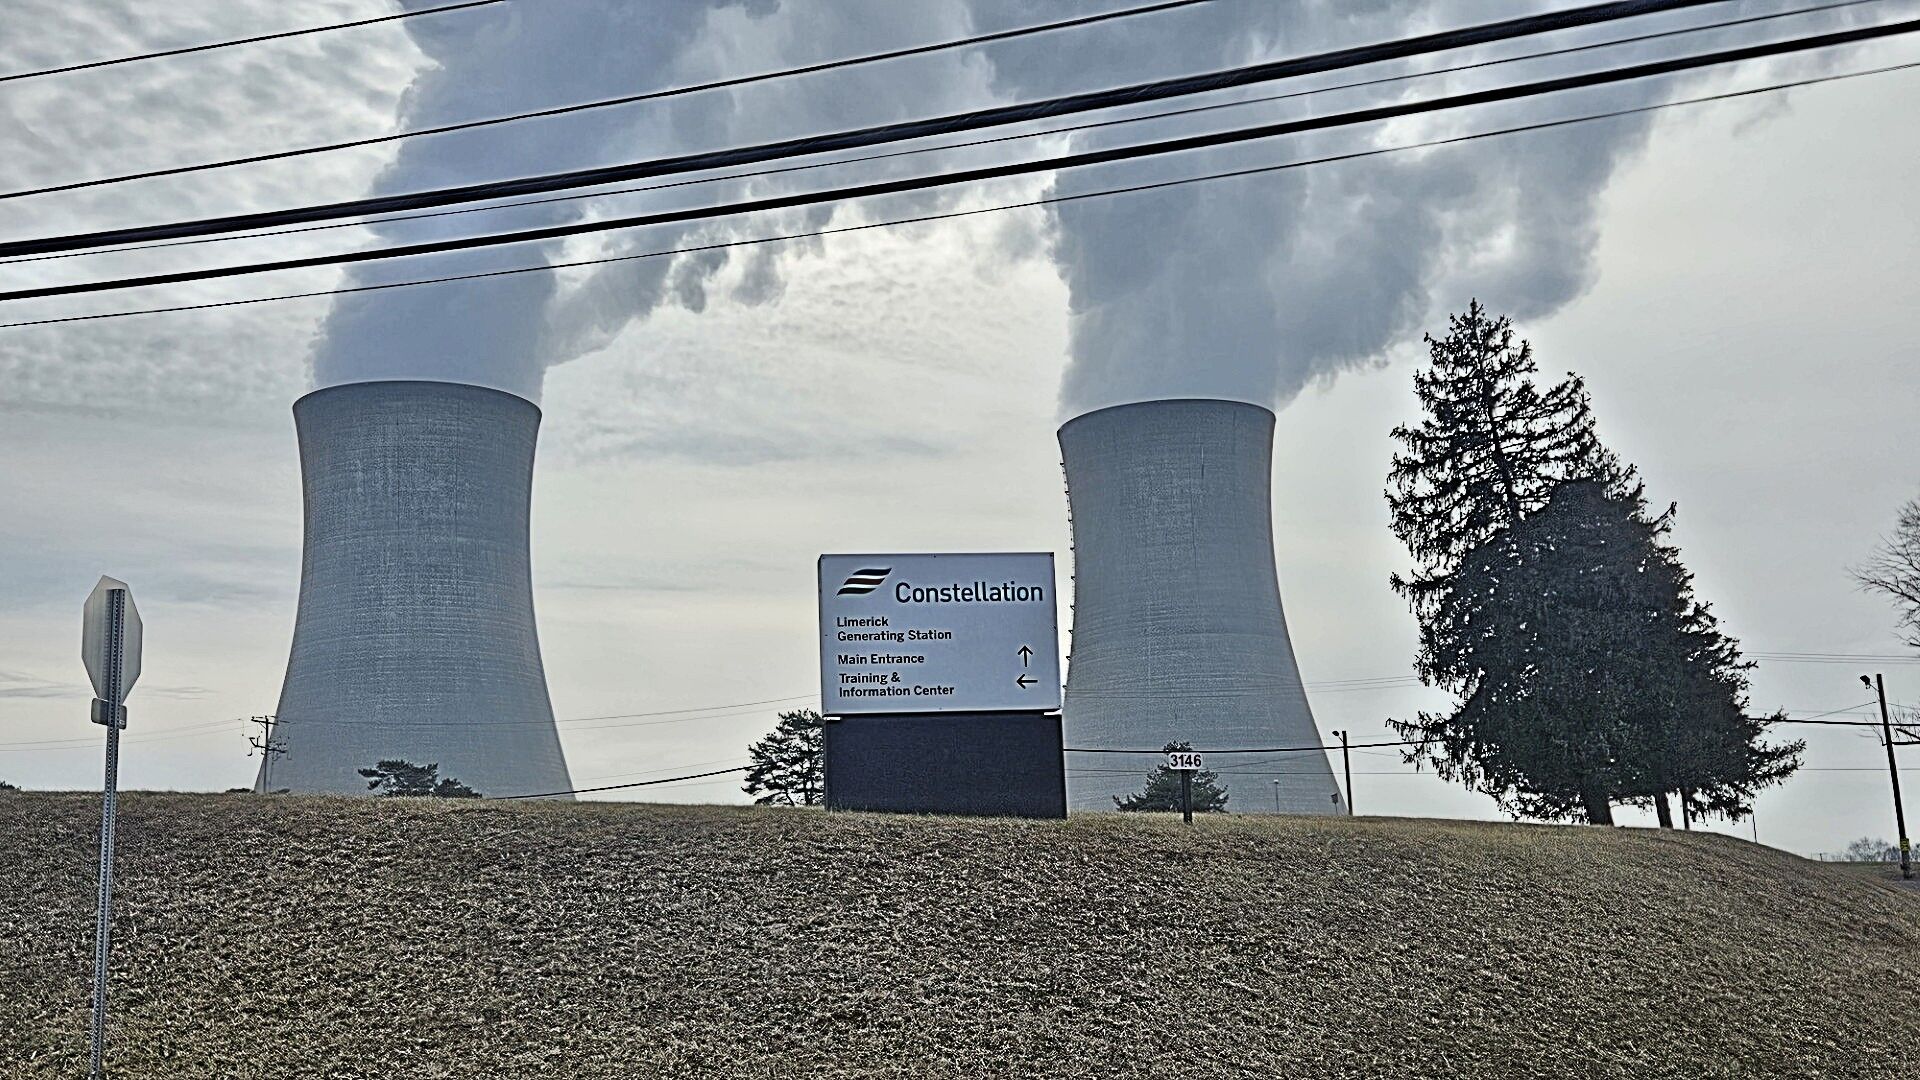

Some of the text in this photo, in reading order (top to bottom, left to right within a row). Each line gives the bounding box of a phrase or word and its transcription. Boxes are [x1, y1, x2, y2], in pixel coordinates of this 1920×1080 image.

[895, 580, 1044, 604] Constellation
[836, 616, 889, 627] Limerick
[837, 630, 952, 642] Generating Station
[837, 653, 925, 665] Main Entrance
[839, 671, 901, 685] Training &
[839, 685, 955, 698] Information Center
[1170, 754, 1202, 767] 3146
